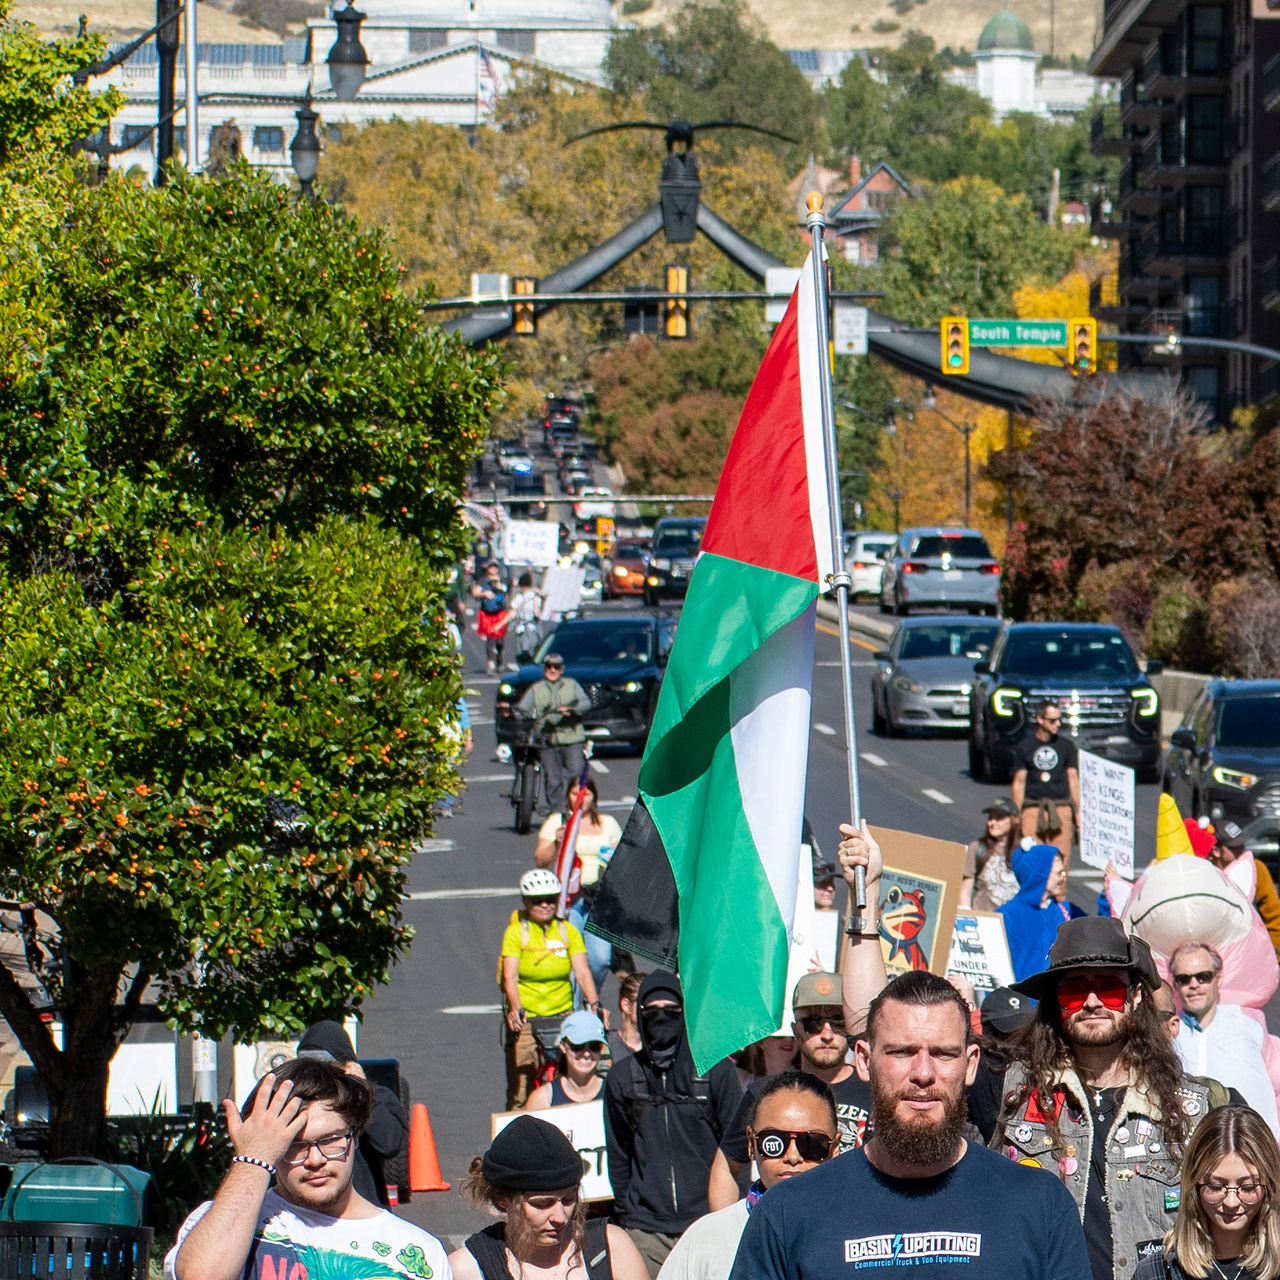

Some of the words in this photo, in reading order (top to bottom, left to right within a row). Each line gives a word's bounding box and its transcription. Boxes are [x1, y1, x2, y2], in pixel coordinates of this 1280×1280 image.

[971, 326, 1009, 340] South
[1015, 326, 1062, 342] Temple
[1084, 760, 1098, 776] WE
[1104, 764, 1126, 783] WANT
[1084, 778, 1097, 794] NO
[1099, 785, 1126, 804] KINGS
[1085, 796, 1098, 811] NO
[1099, 800, 1134, 820] DICTATORS
[1084, 811, 1098, 826] NO
[1084, 824, 1097, 839] NO
[1085, 839, 1098, 857] IN
[1099, 843, 1113, 863] THE
[1115, 849, 1133, 869] USA
[917, 881, 939, 893] REPEAT.
[953, 959, 988, 971] UNDER
[765, 1141, 780, 1153] FDT
[850, 1239, 892, 1258] BASIN
[904, 1235, 976, 1254] UPFITTING
[855, 1258, 894, 1269] Commercial
[896, 1257, 913, 1266] Truck
[915, 1257, 920, 1265] &
[922, 1256, 934, 1264] Van
[936, 1255, 970, 1264] Equipment
